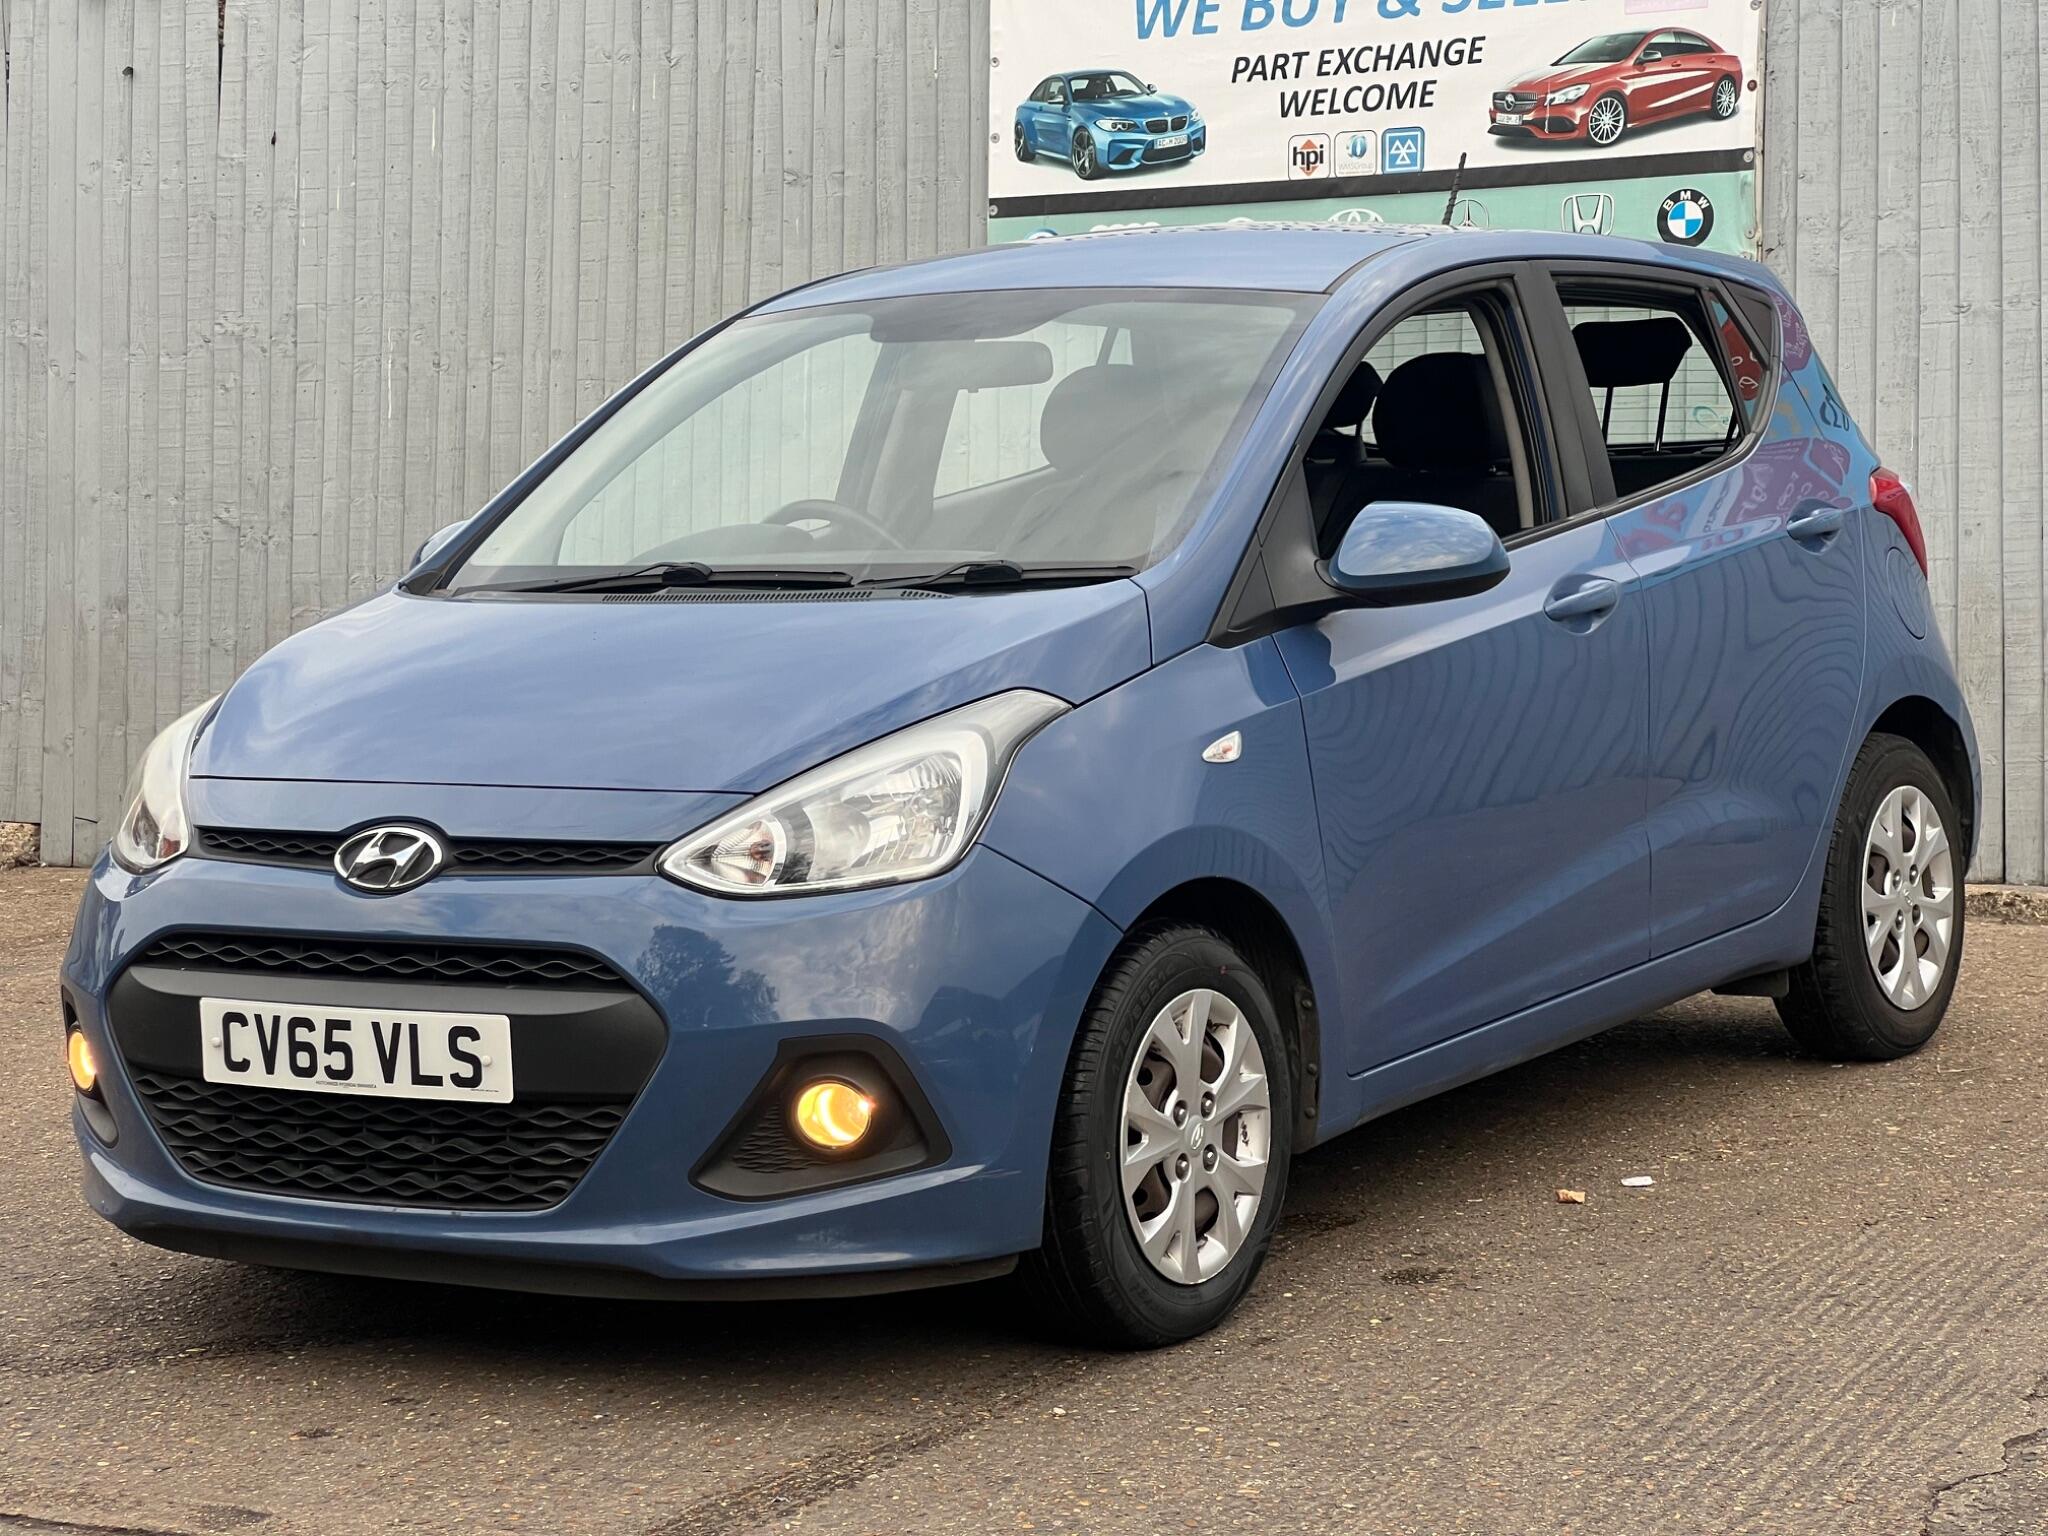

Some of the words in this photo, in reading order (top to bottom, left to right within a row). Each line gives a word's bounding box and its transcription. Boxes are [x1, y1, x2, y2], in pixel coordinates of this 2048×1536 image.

[1135, 0, 1220, 39] WE
[1231, 51, 1310, 83] PART
[1316, 36, 1487, 77] EXCHANGE
[1279, 79, 1438, 118] WELCOME
[1292, 144, 1324, 171] hpi
[1662, 190, 1710, 211] BMW
[222, 1011, 354, 1081] CV65
[371, 1021, 483, 1089] VLS
